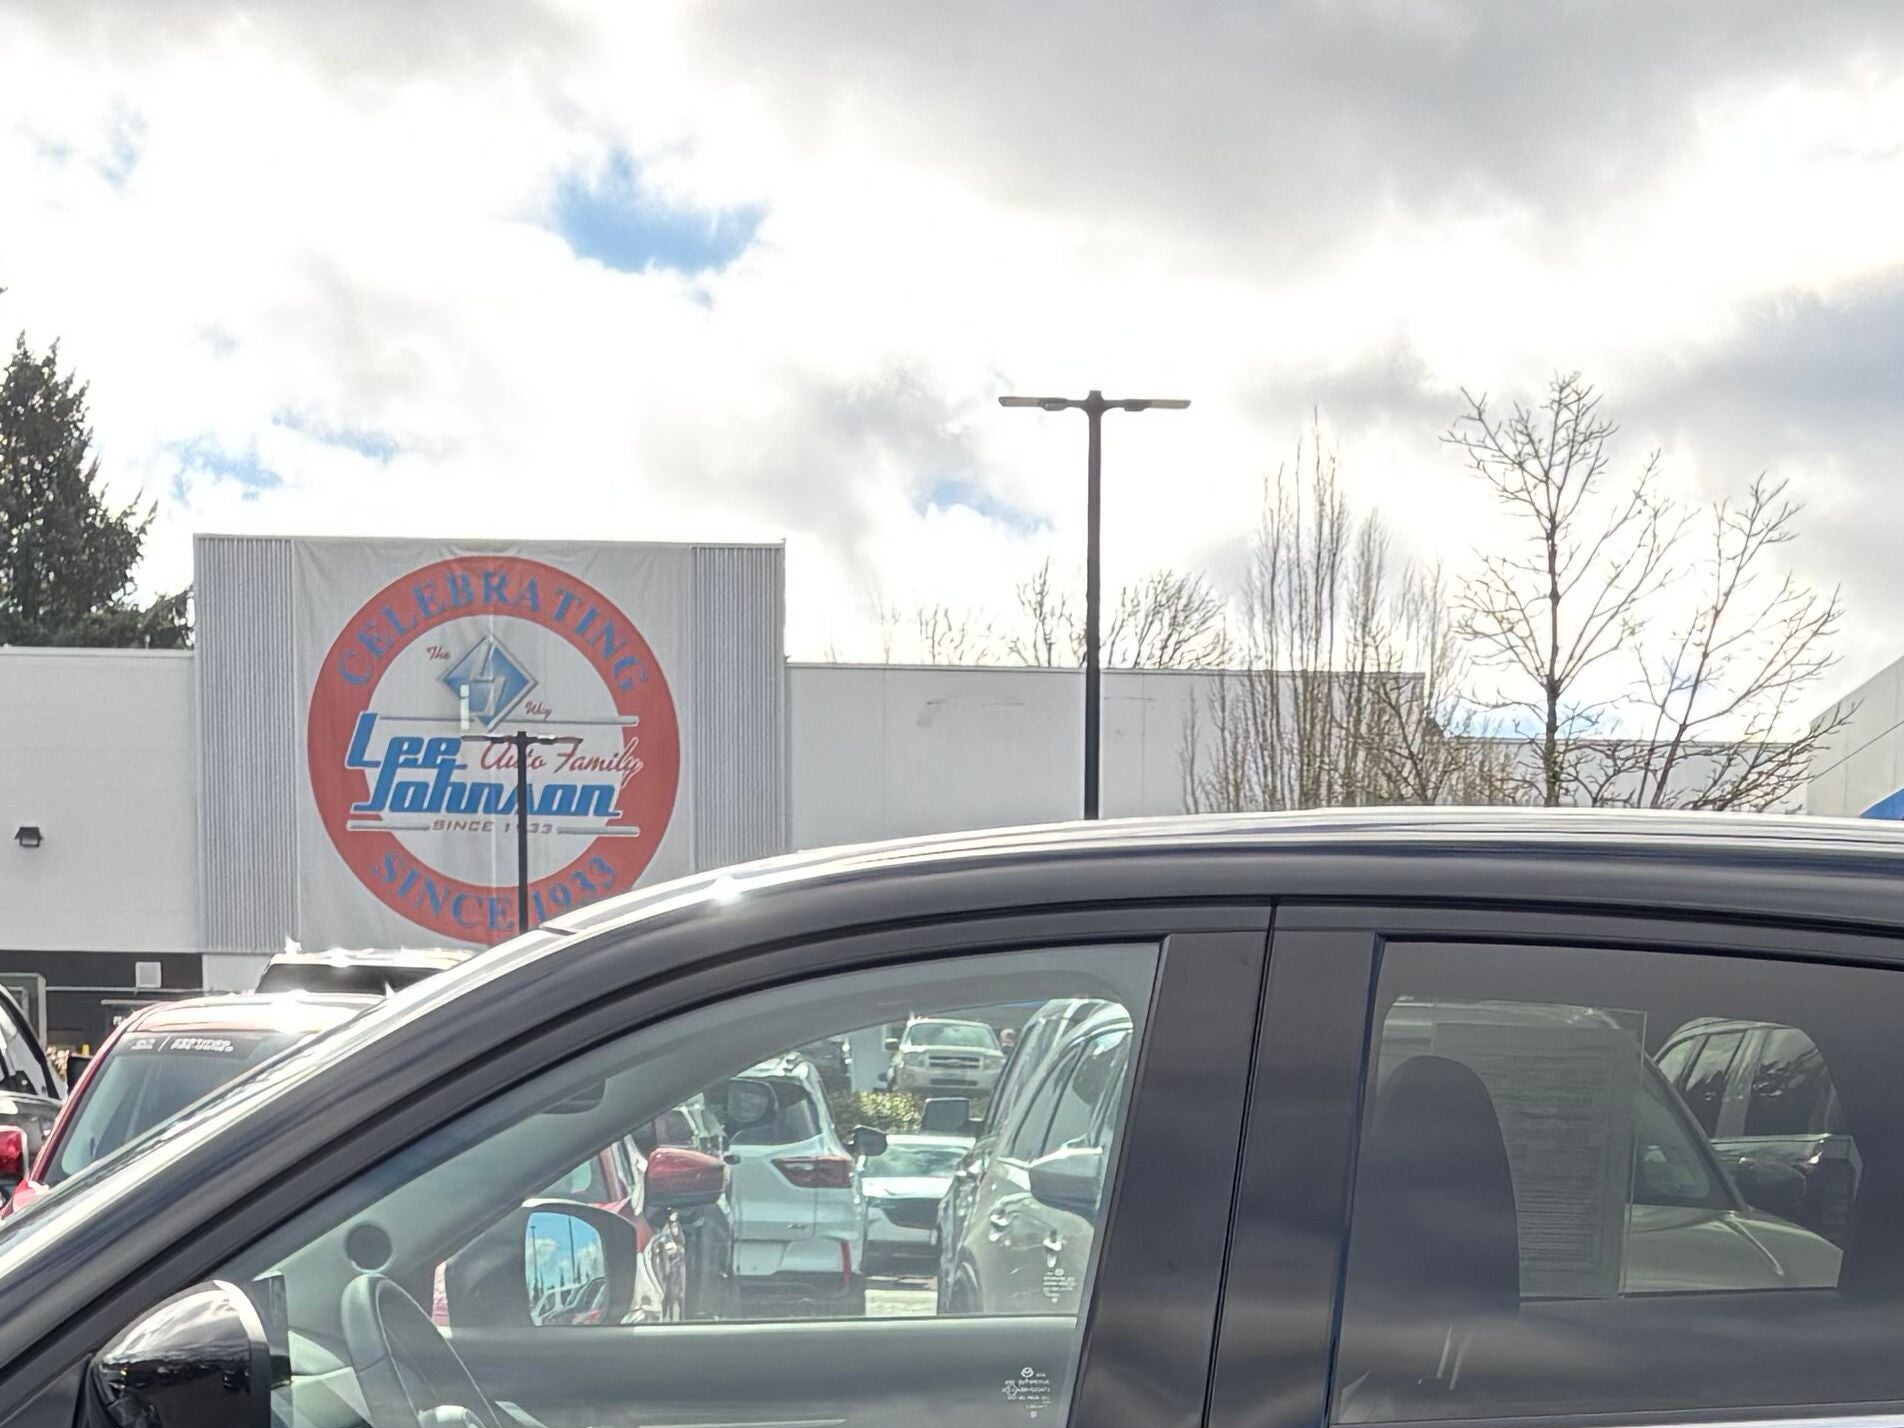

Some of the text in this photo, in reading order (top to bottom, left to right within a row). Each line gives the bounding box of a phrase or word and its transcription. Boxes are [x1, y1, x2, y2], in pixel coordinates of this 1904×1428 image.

[338, 570, 650, 694] CELEBRATING
[426, 646, 450, 660] The
[525, 701, 552, 719] Way
[347, 713, 467, 769] Lee
[554, 736, 644, 787] Family
[351, 758, 621, 817] Johnson
[432, 820, 552, 834] SINCE 133
[370, 852, 615, 932] SINCE 1933
